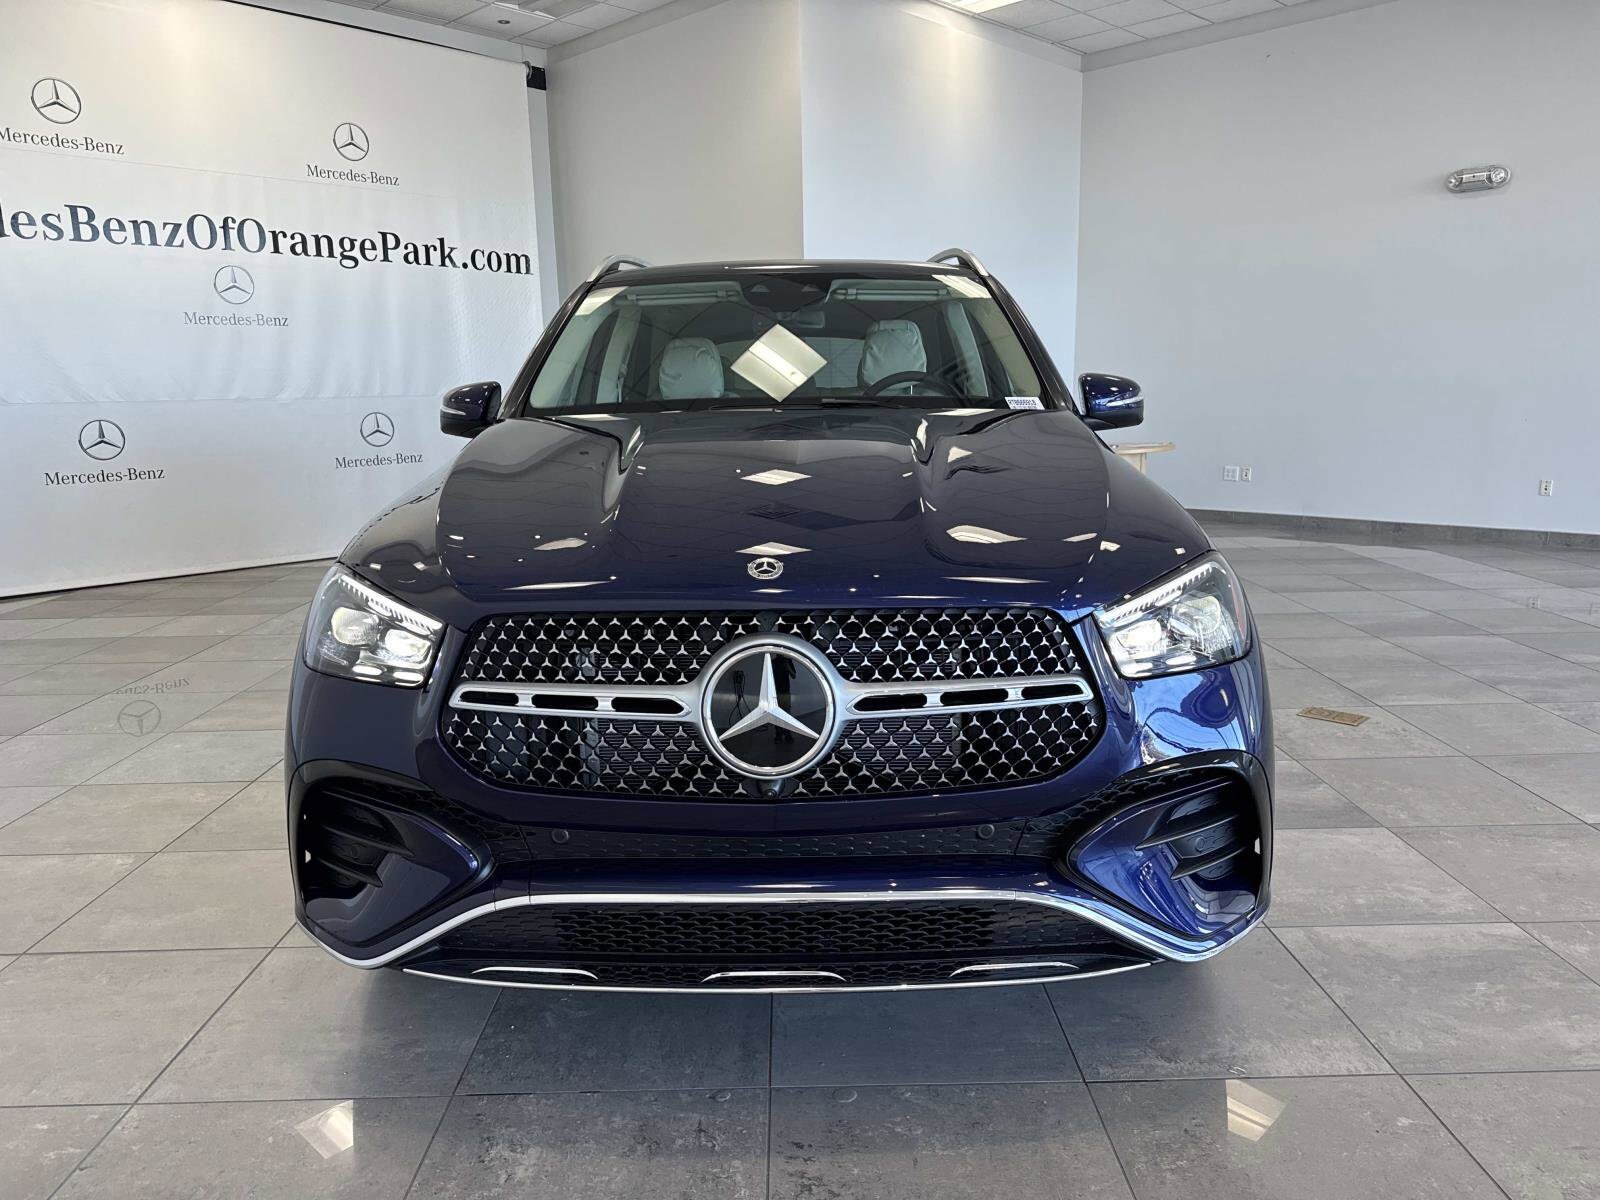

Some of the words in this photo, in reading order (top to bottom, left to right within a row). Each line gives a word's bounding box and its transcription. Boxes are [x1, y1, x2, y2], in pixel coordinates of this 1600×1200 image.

[305, 163, 400, 186] Mercedes-Benz
[183, 311, 289, 328] Mercedes-Benz
[334, 452, 424, 471] Mercedes-Benz
[44, 465, 165, 486] Mercedes-Benz
